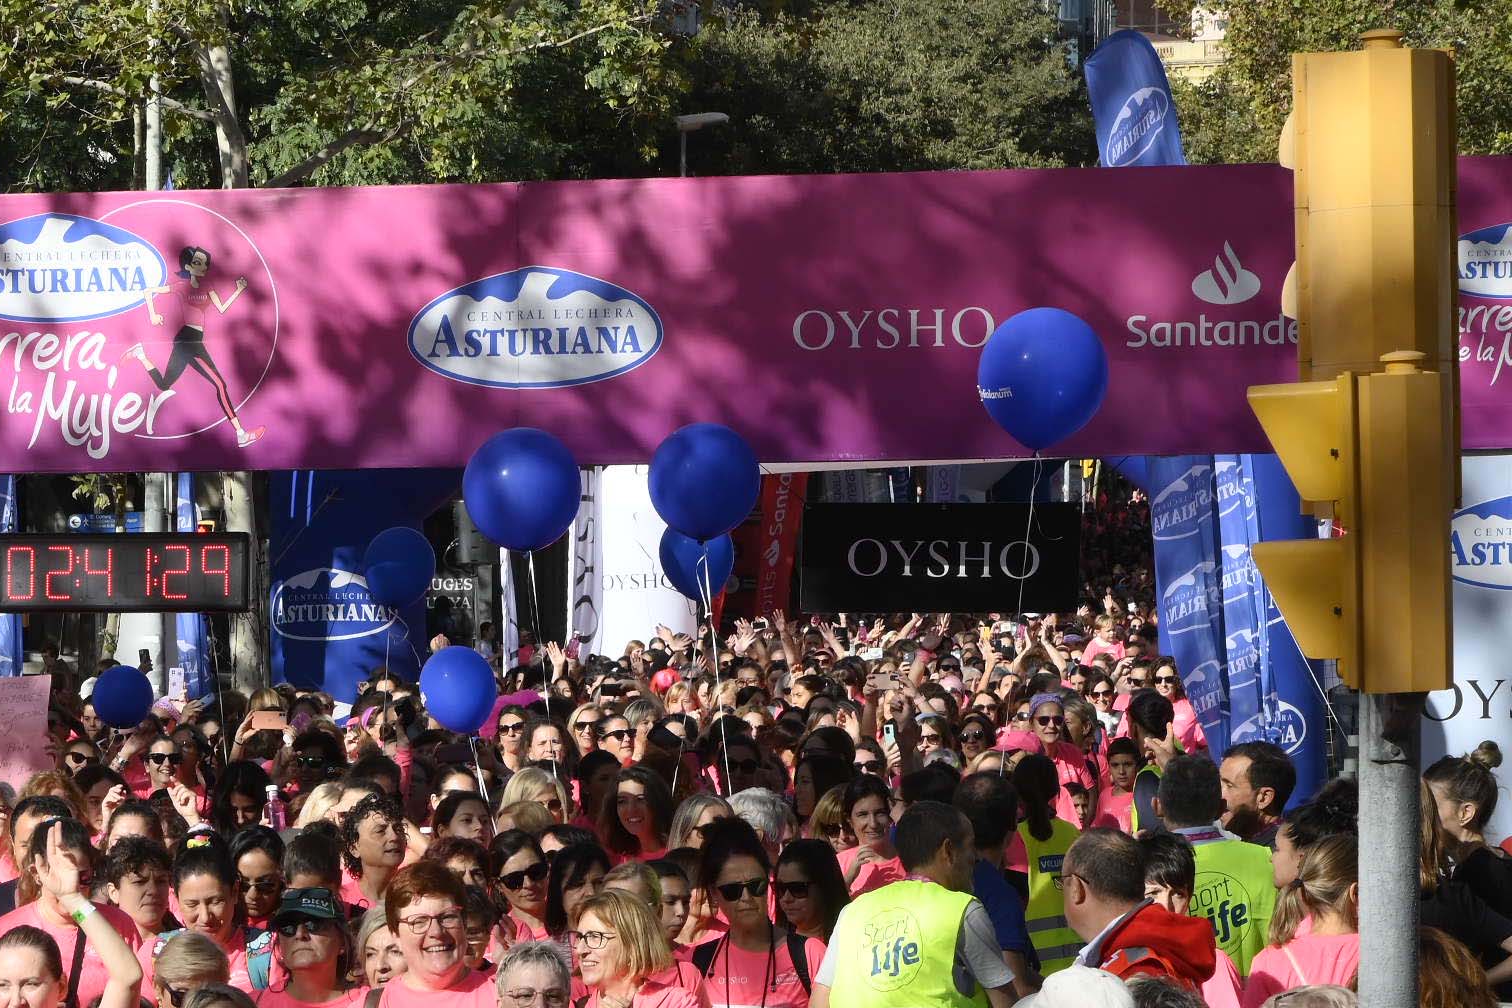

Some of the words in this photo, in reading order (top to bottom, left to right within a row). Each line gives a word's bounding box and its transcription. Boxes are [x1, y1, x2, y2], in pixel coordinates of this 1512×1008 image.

[70, 250, 142, 262] LECHERA
[467, 308, 547, 323] CENTRAL
[553, 306, 635, 321] LECHERA
[792, 305, 996, 351] OYSHO
[1126, 313, 1300, 349] Santande
[427, 314, 643, 358] ASTURIANA
[7, 375, 33, 414] la
[27, 366, 177, 460] Mujer
[847, 538, 1040, 580] OYSHO
[431, 577, 473, 591] UGES
[275, 597, 390, 625] ASTURIANA
[1205, 900, 1248, 943] ife
